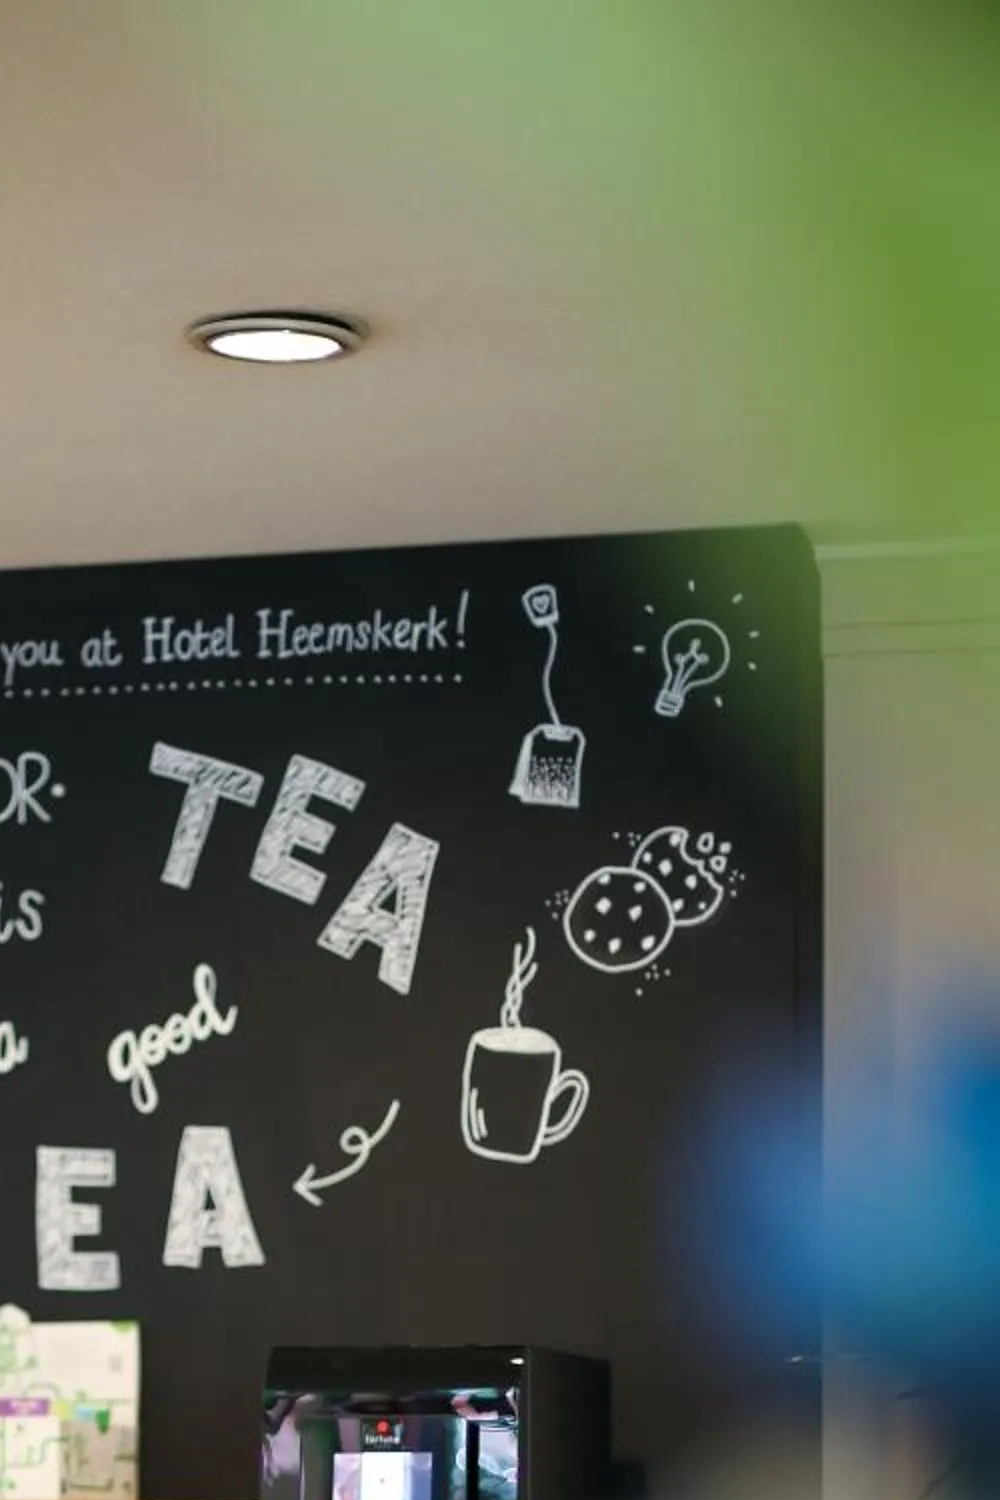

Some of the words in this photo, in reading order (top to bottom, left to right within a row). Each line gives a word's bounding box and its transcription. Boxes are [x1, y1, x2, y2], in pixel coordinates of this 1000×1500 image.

[0, 641, 63, 686] you
[81, 629, 123, 668] at
[142, 612, 240, 664] Hotel
[256, 590, 469, 660] Heemskerk!
[148, 741, 441, 995] TEA
[107, 963, 239, 1115] good
